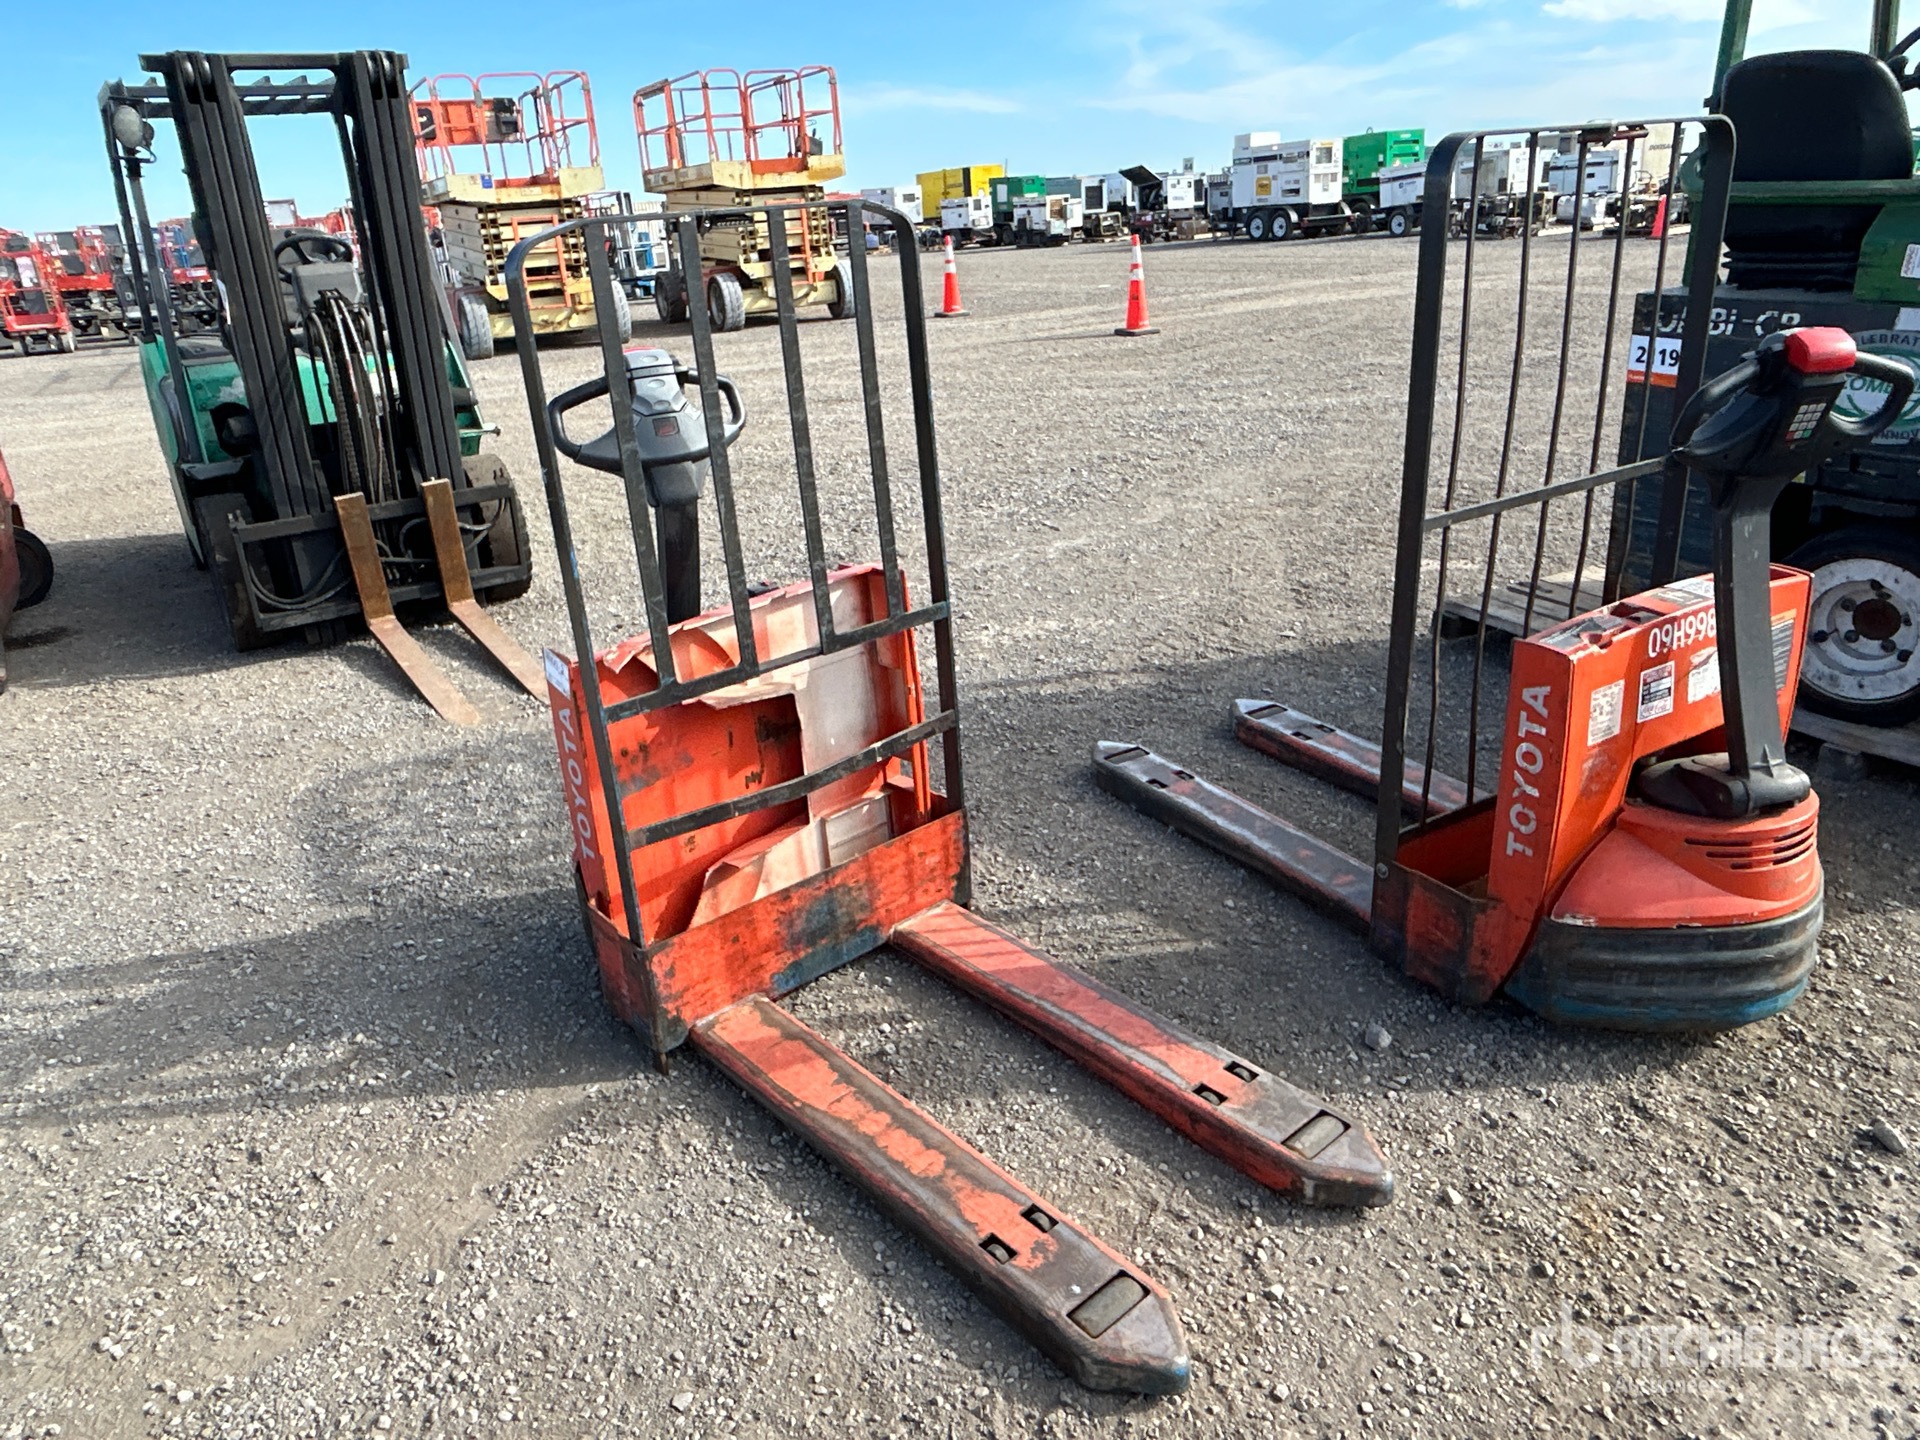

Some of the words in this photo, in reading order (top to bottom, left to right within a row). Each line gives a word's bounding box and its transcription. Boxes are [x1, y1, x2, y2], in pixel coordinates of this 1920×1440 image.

[1635, 346, 1680, 367] 219
[559, 708, 595, 860] TOYOTA
[1506, 685, 1551, 857] TOYOTA
